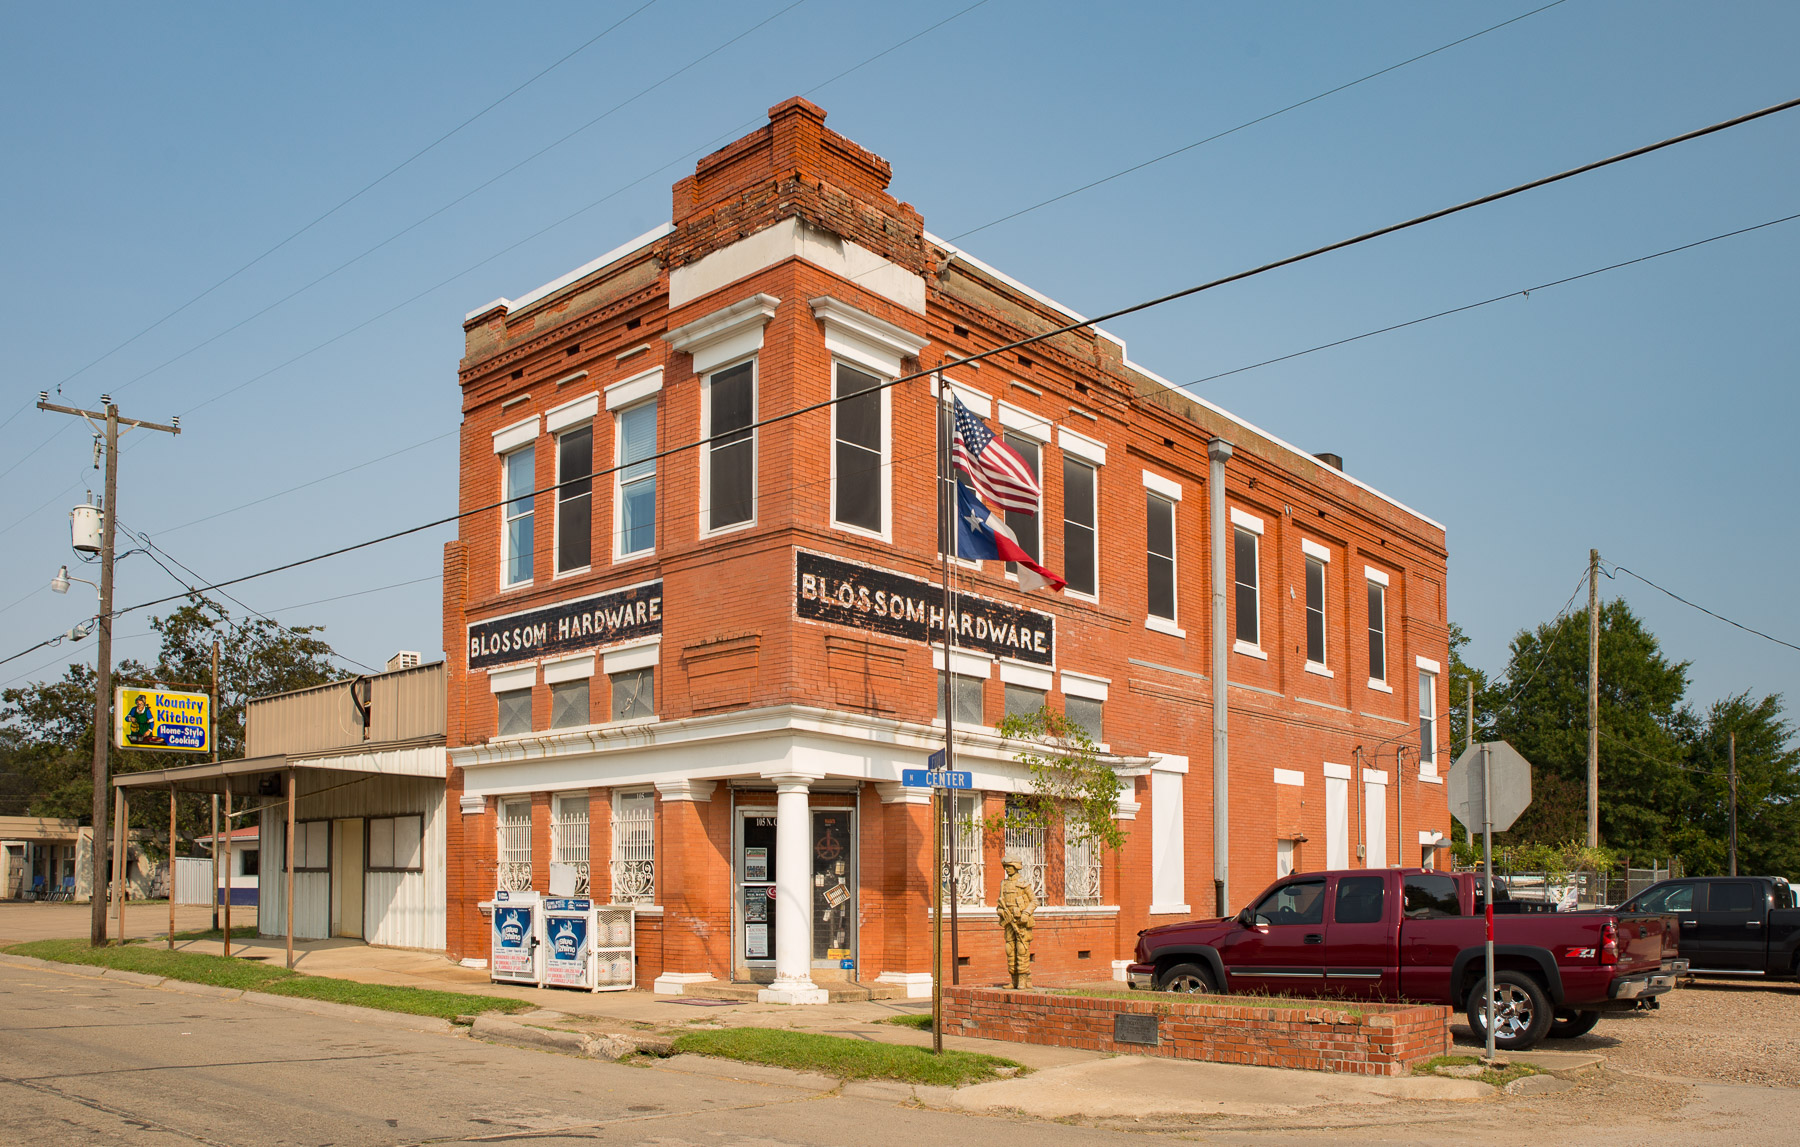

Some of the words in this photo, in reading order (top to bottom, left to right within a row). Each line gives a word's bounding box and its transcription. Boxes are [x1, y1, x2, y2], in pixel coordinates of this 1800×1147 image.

[803, 573, 925, 624] BLOSSOM
[930, 605, 1047, 654] HARDWARE
[471, 622, 547, 658] BLOSSOM
[558, 597, 662, 640] HARDWARE
[155, 694, 203, 713] Kountry
[157, 709, 202, 724] Kitchen
[160, 725, 204, 737] Home-Style
[169, 736, 200, 747] Cooking
[926, 772, 965, 787] CENTER
[756, 817, 766, 827] 105
